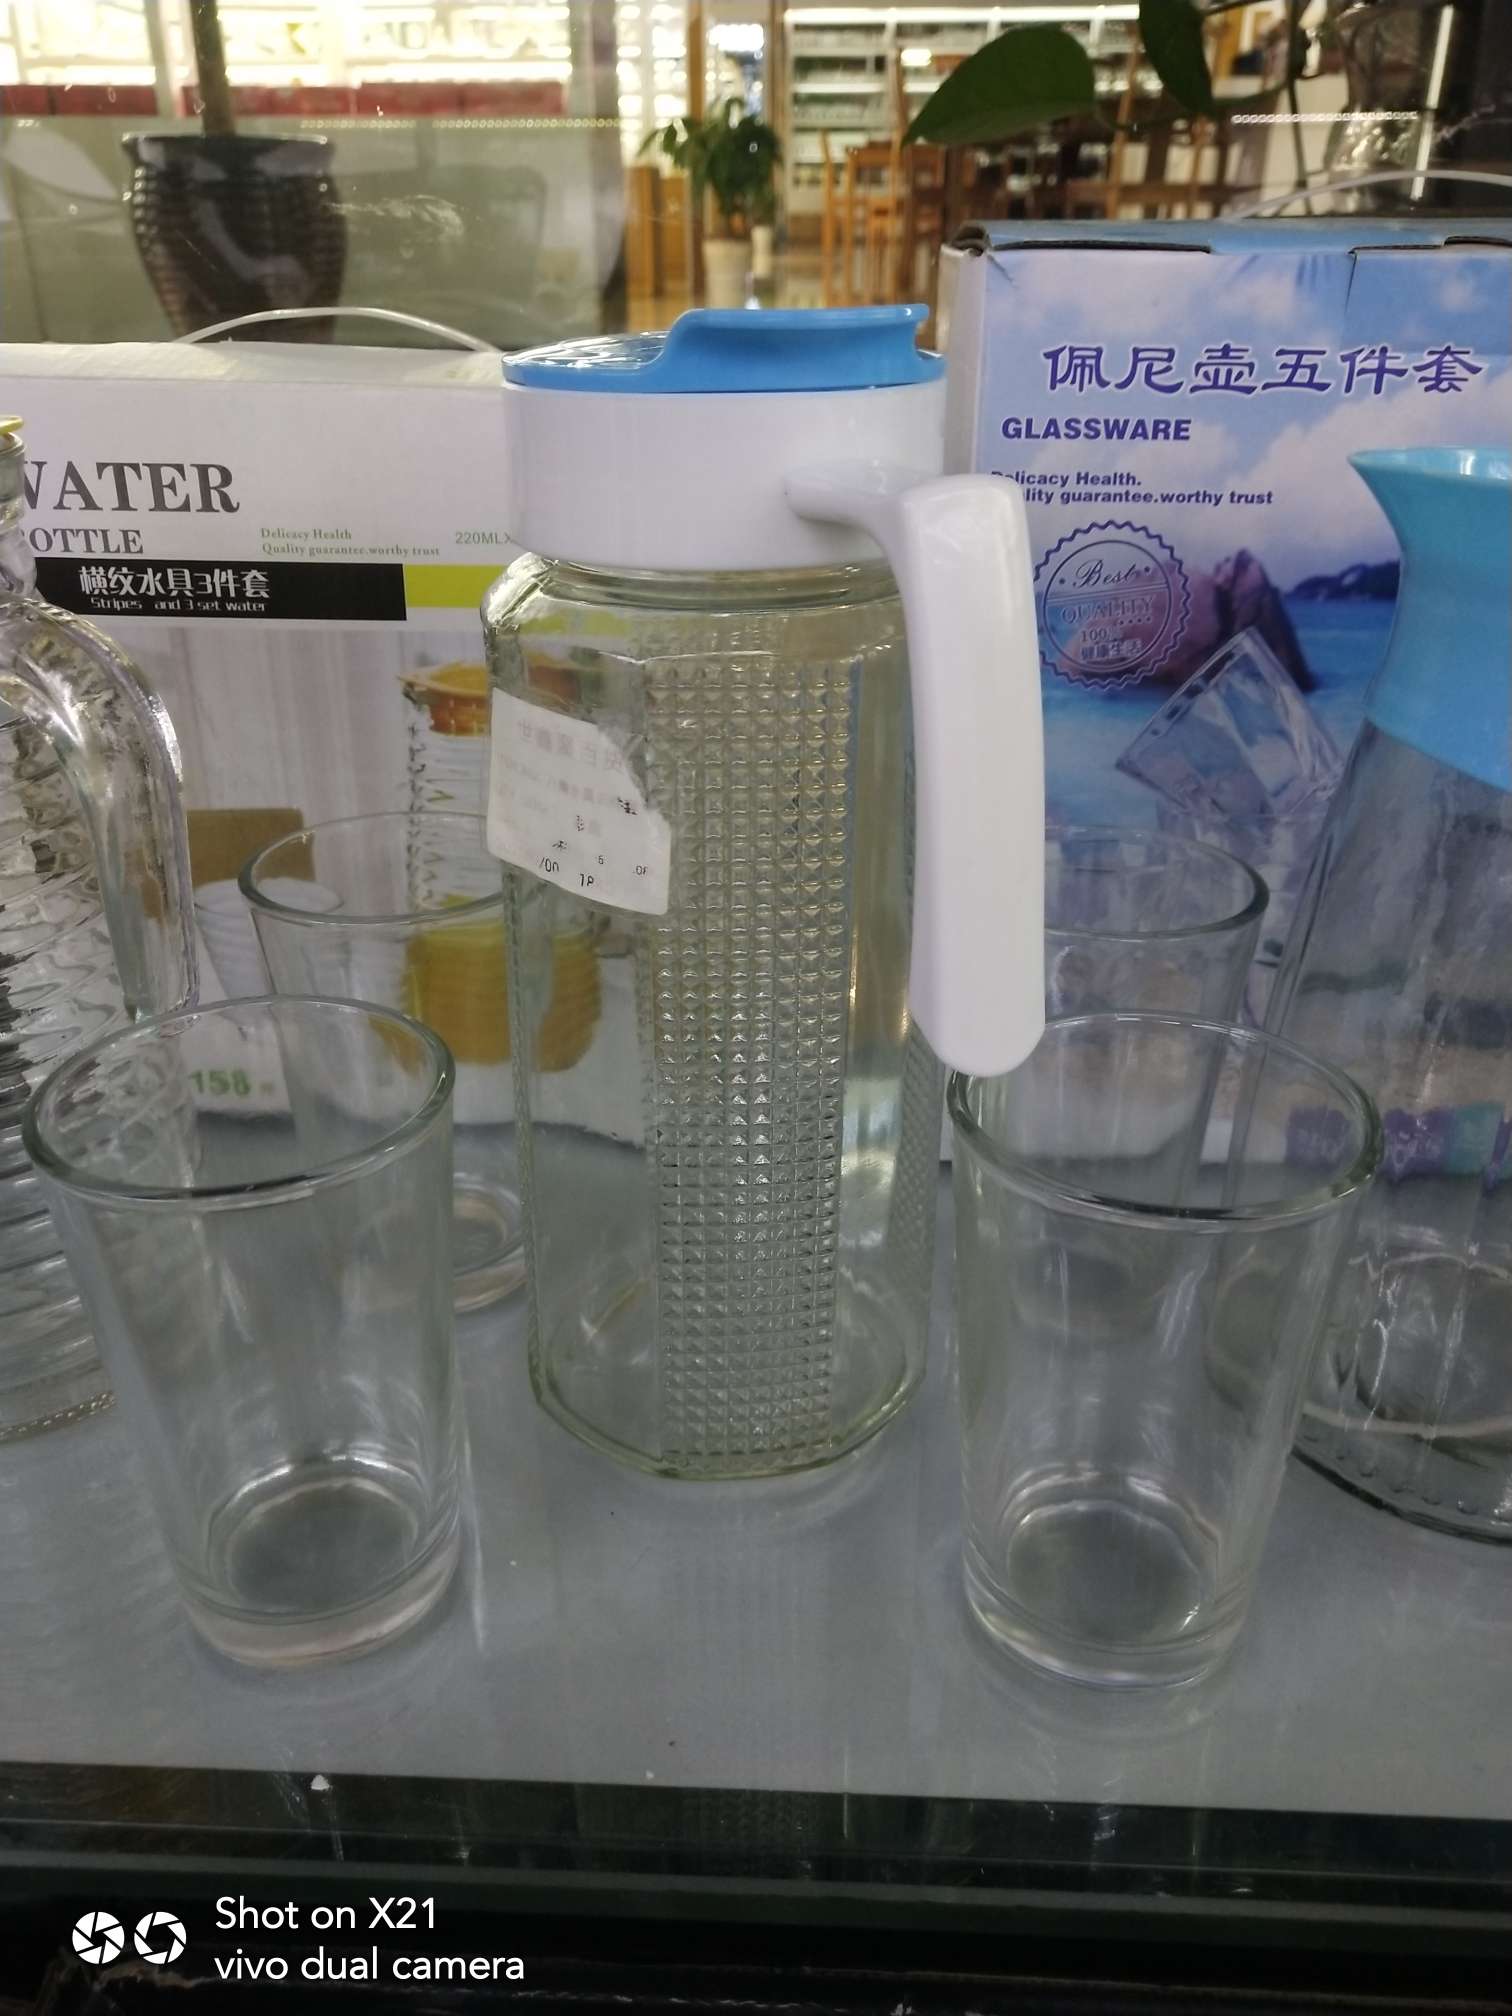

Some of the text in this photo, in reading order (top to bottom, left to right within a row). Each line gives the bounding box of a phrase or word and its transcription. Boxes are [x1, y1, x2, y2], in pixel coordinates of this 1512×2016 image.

[1043, 344, 1482, 395] 佩尼壶五件套
[1002, 417, 1192, 440] GLASSWARE
[991, 471, 1141, 488] licacy Health.
[1023, 488, 1273, 507] lity guarantee.worthy trust
[21, 527, 143, 554] OTTLE
[313, 529, 352, 541] Health
[262, 543, 306, 557] Quality
[412, 546, 439, 556] trust
[78, 566, 270, 598] 横纹水具3件套
[90, 597, 143, 611] Stripes
[154, 599, 180, 610] and
[197, 600, 221, 611] set
[225, 602, 265, 612] water
[1061, 596, 1156, 624] QUALITY
